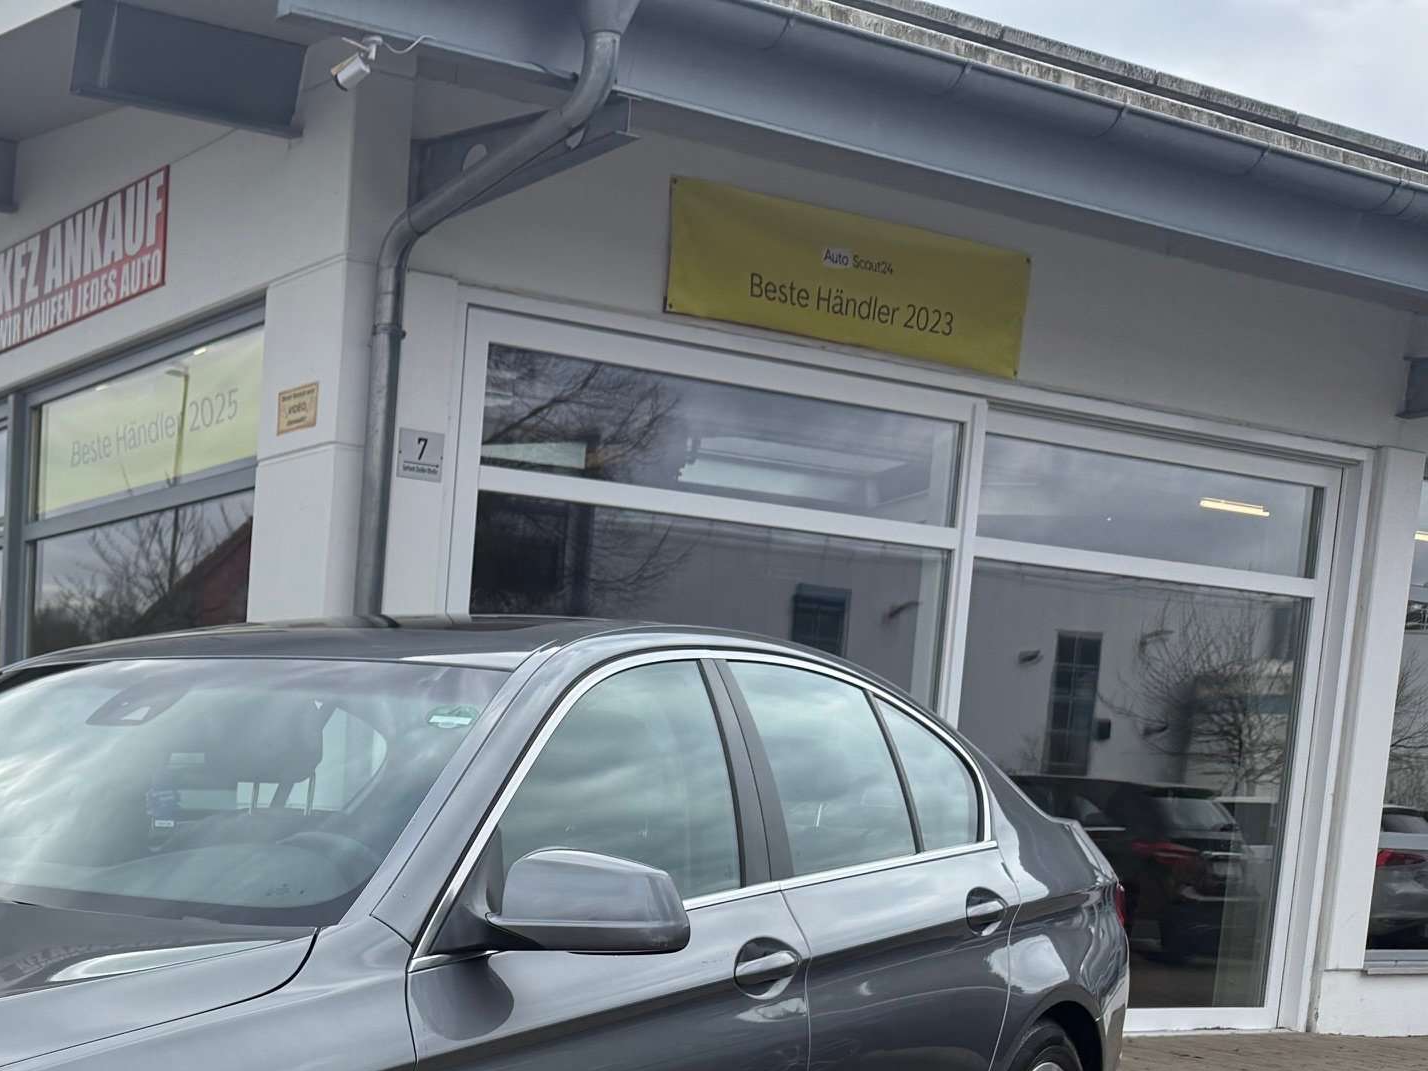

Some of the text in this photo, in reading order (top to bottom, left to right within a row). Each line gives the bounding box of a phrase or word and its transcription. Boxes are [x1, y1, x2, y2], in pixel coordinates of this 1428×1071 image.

[43, 170, 164, 295] ANKAUF
[824, 248, 894, 275] Auto Scout24
[23, 288, 73, 340] KAUFEN
[75, 268, 118, 319] JEDES
[120, 249, 162, 300] AUTO
[750, 272, 955, 337] Beste Händler 2023
[71, 434, 112, 468] Beste
[189, 388, 240, 432] 2025
[418, 436, 428, 461] 7
